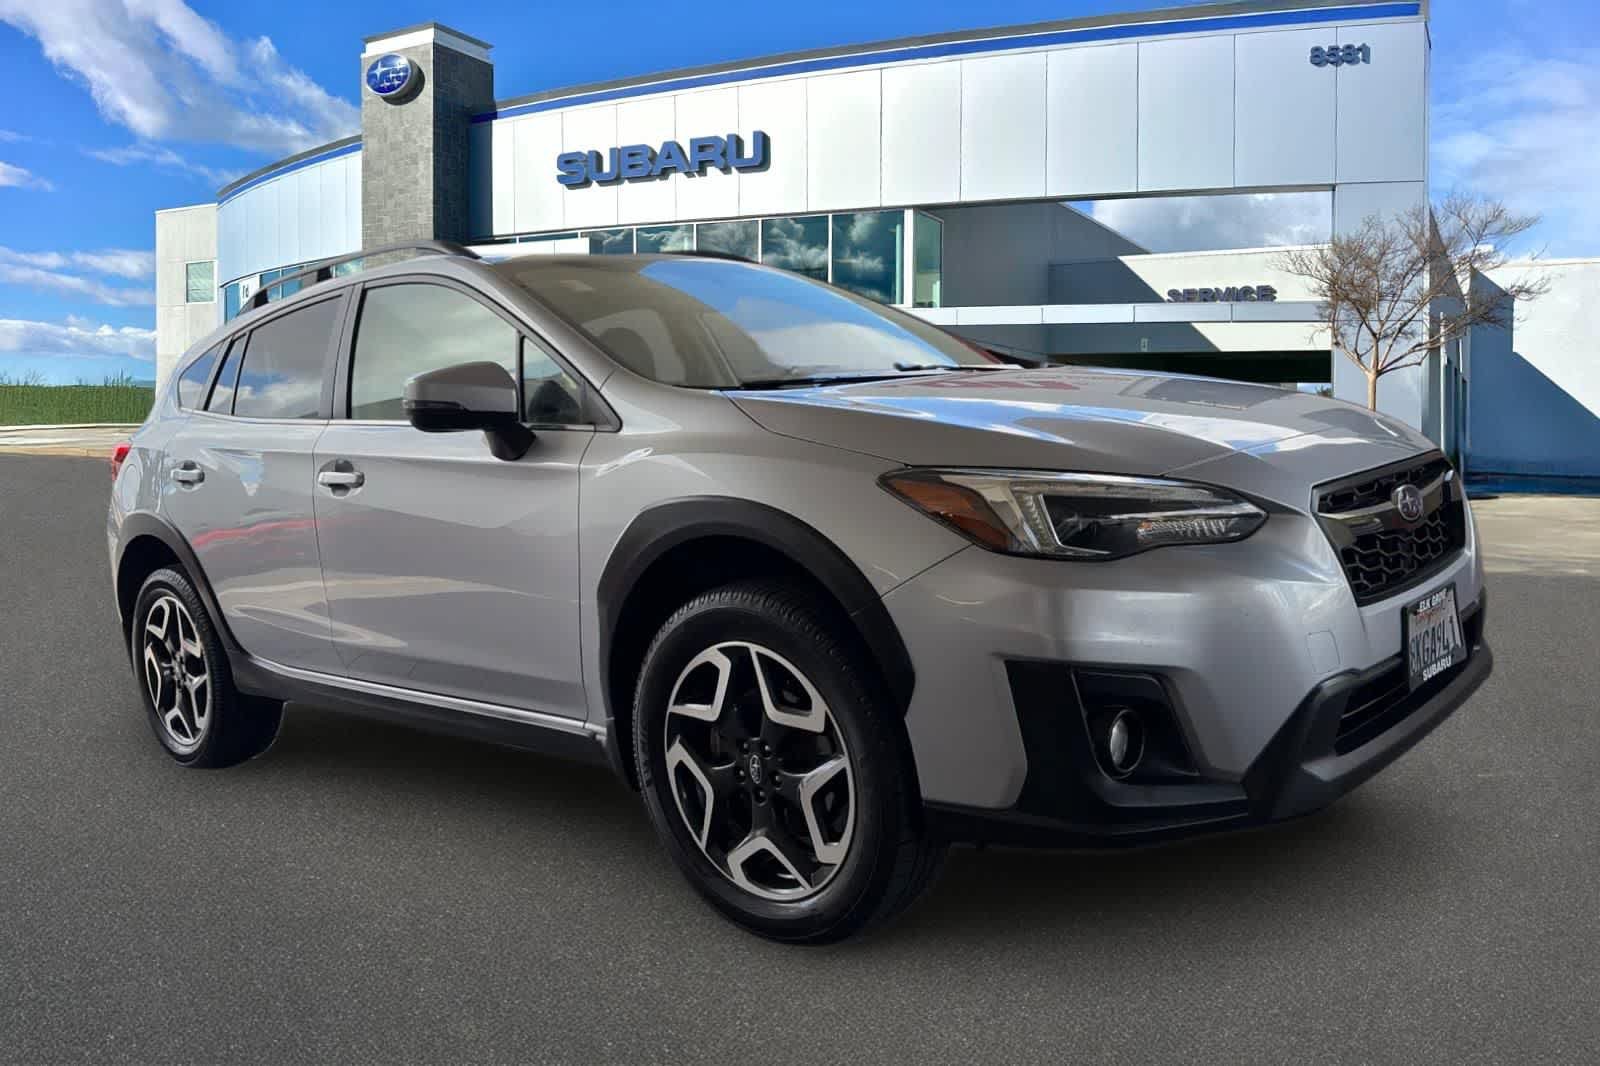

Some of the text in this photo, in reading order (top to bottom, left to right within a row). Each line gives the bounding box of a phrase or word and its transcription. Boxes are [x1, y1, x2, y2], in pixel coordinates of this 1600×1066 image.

[557, 130, 771, 190] SUBARU
[1167, 285, 1277, 302] SERVICE
[1422, 655, 1452, 681] SUBARU
